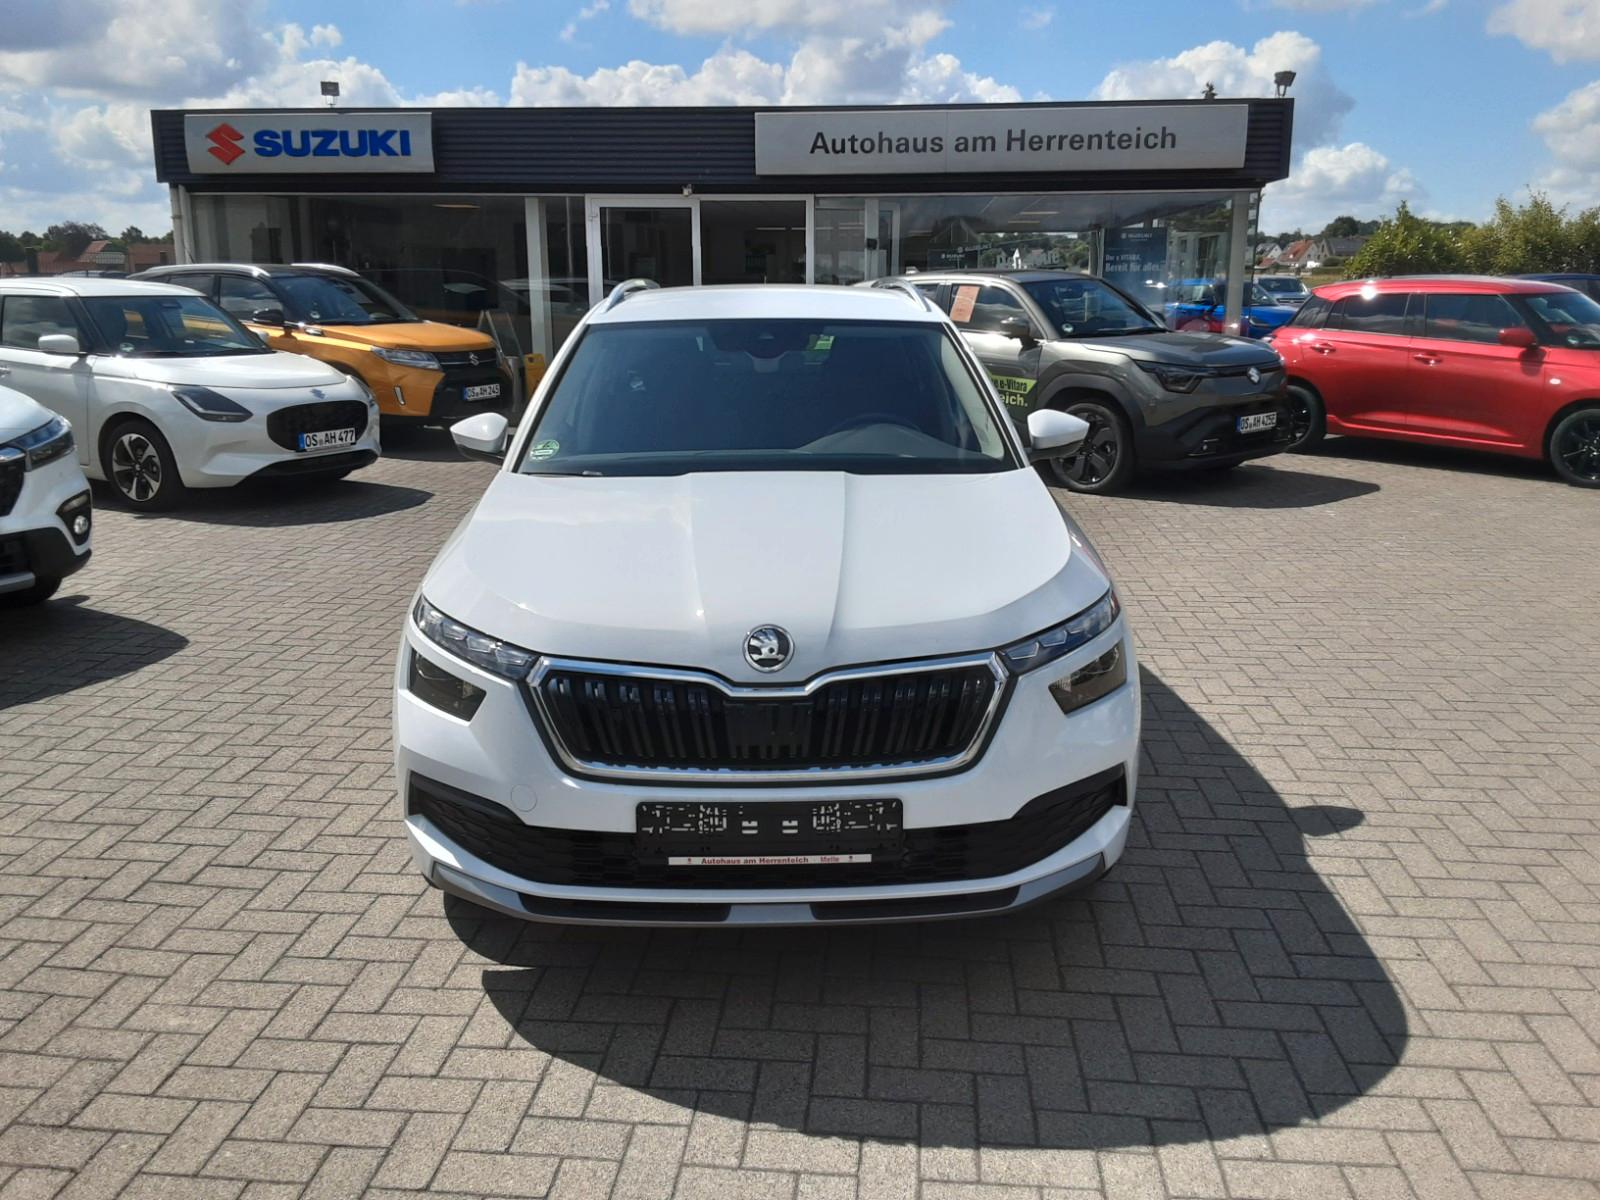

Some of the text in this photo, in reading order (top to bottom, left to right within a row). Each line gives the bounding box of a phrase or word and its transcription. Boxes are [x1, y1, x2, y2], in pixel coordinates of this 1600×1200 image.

[253, 129, 412, 157] SUZUKI
[810, 126, 1177, 154] Autohaus am Herrenteich
[1105, 262, 1128, 272] Bereit
[1000, 379, 1027, 392] e-Vitara
[999, 392, 1028, 407] eich.
[305, 429, 354, 447] OS AH 477
[701, 857, 741, 865] Autohaus
[759, 856, 809, 864] Herrenteich
